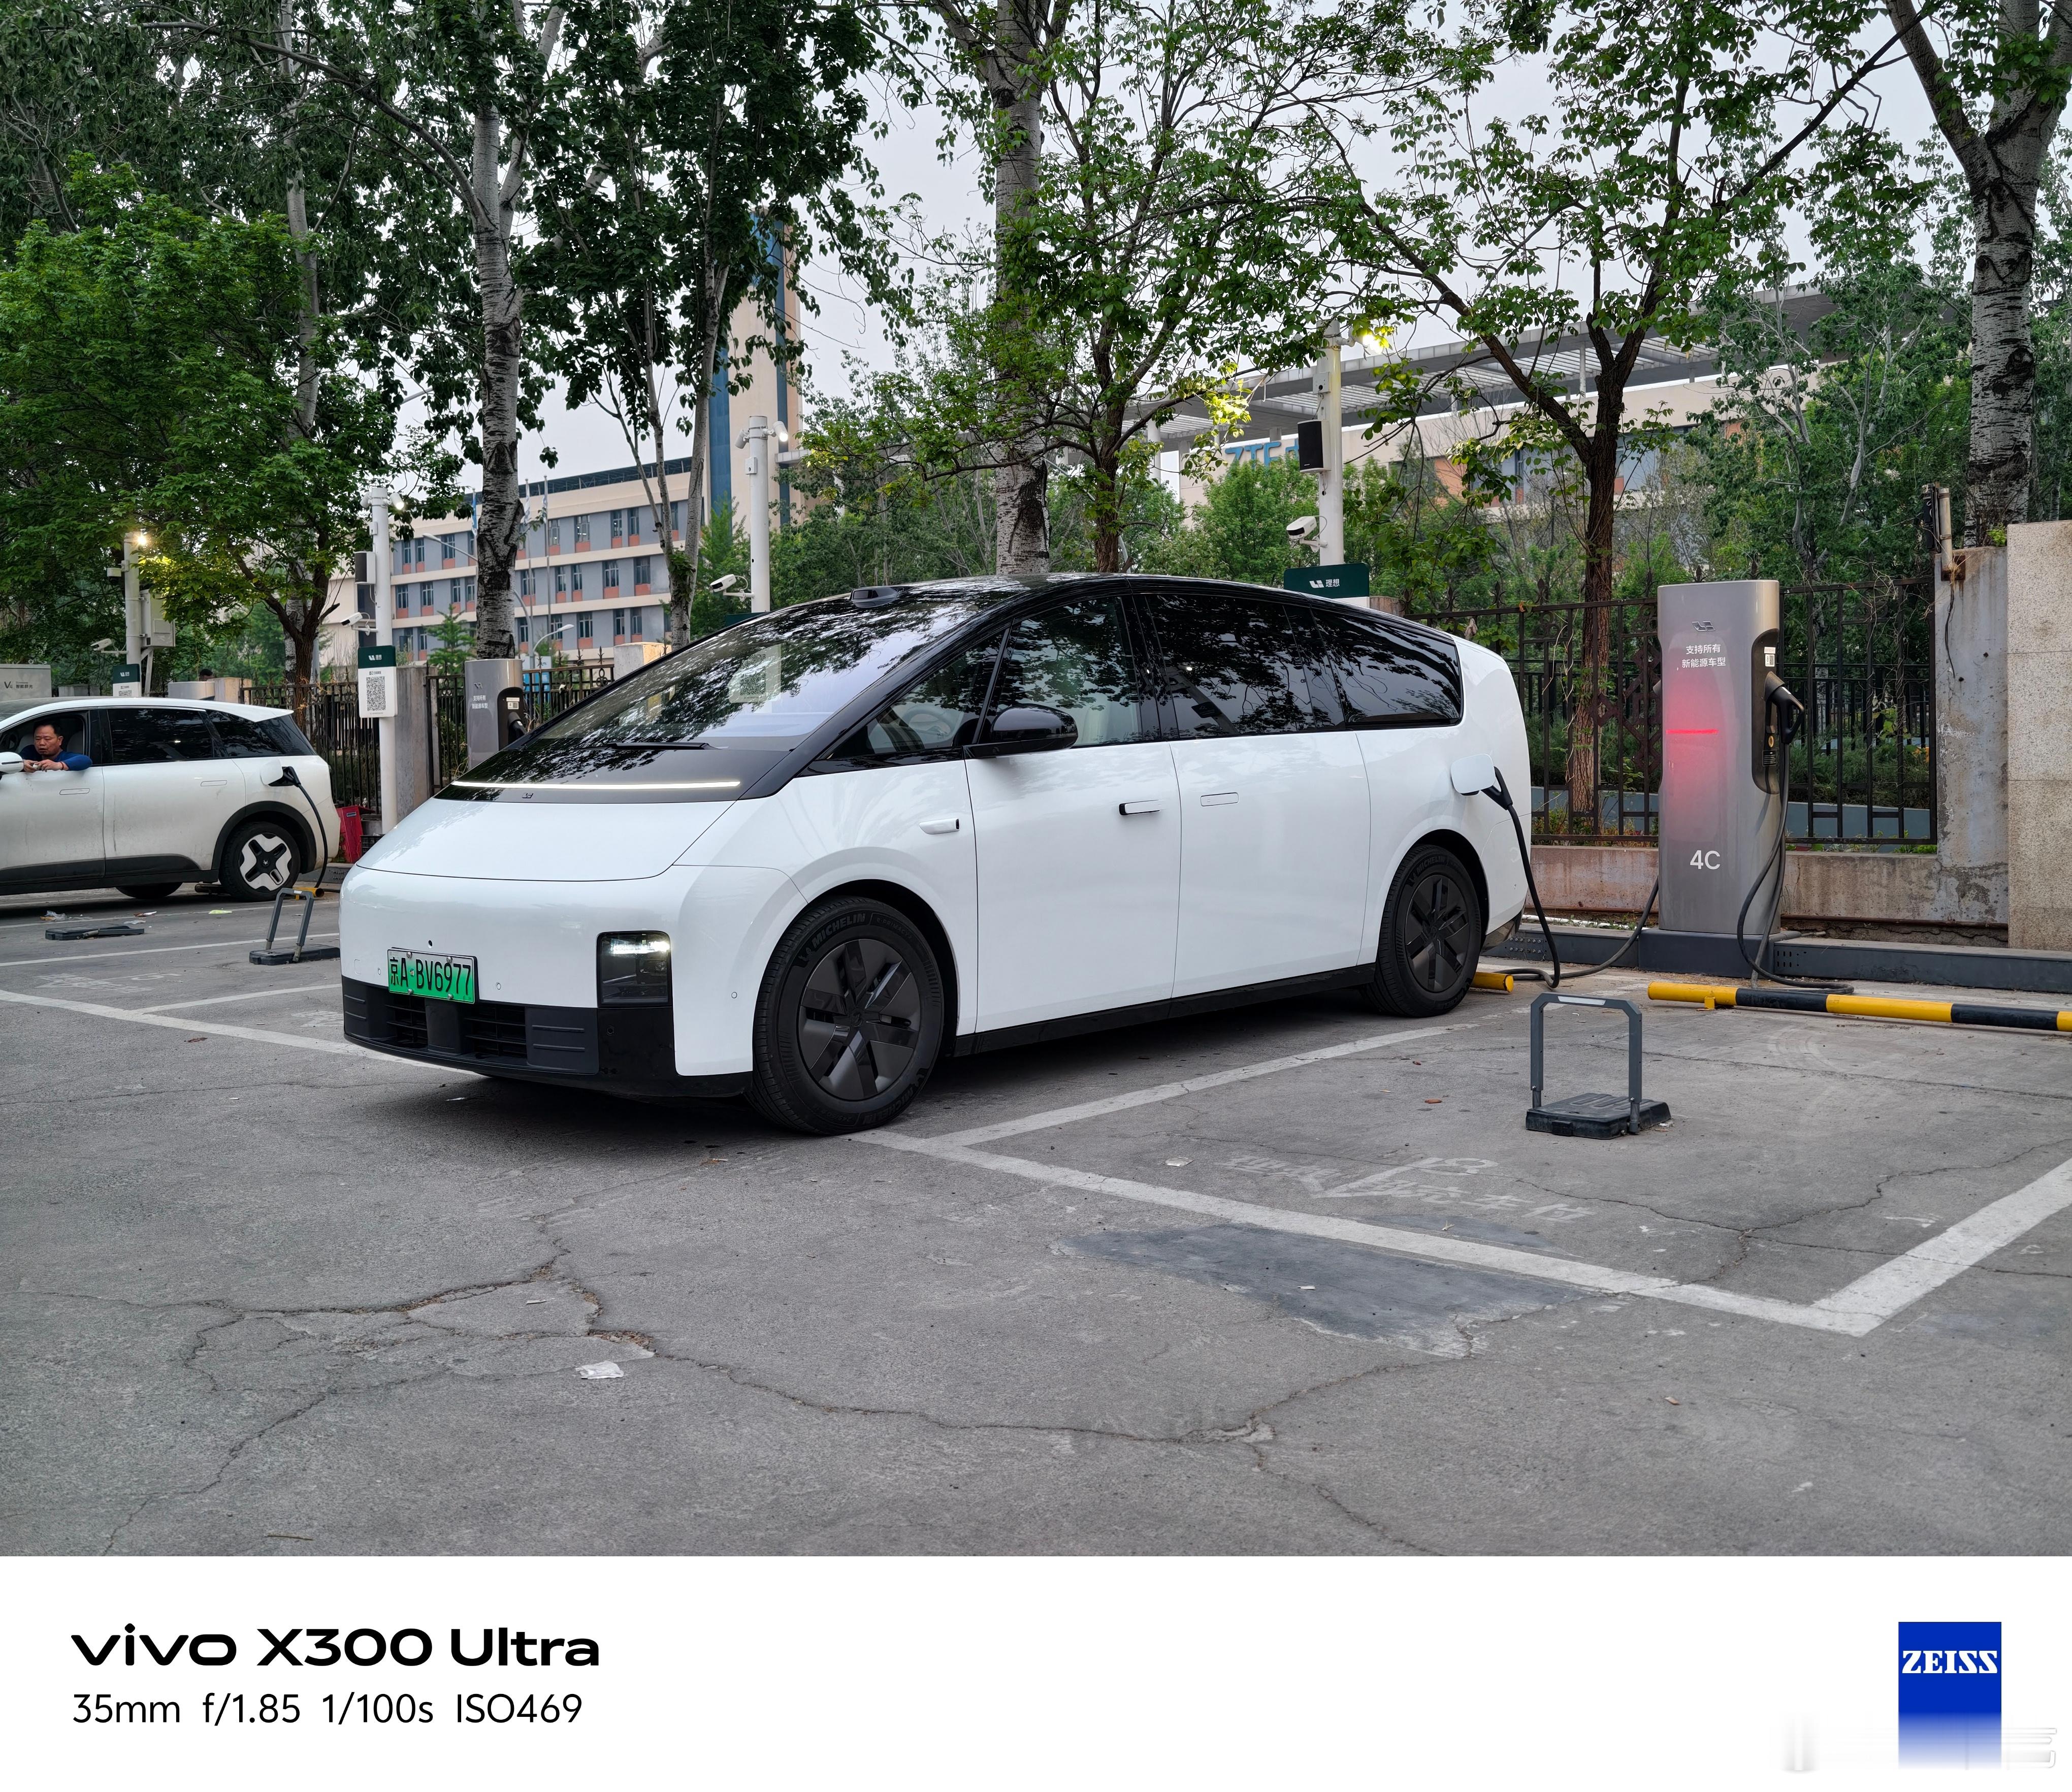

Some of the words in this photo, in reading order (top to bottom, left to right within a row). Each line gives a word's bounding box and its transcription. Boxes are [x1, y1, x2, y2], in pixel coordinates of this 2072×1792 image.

[1325, 579, 1340, 588] 理想
[1686, 644, 1721, 655] 支持所有
[1681, 657, 1726, 668] 新能源车型
[1690, 850, 1721, 870] 4C
[812, 913, 866, 948] MICHELIN
